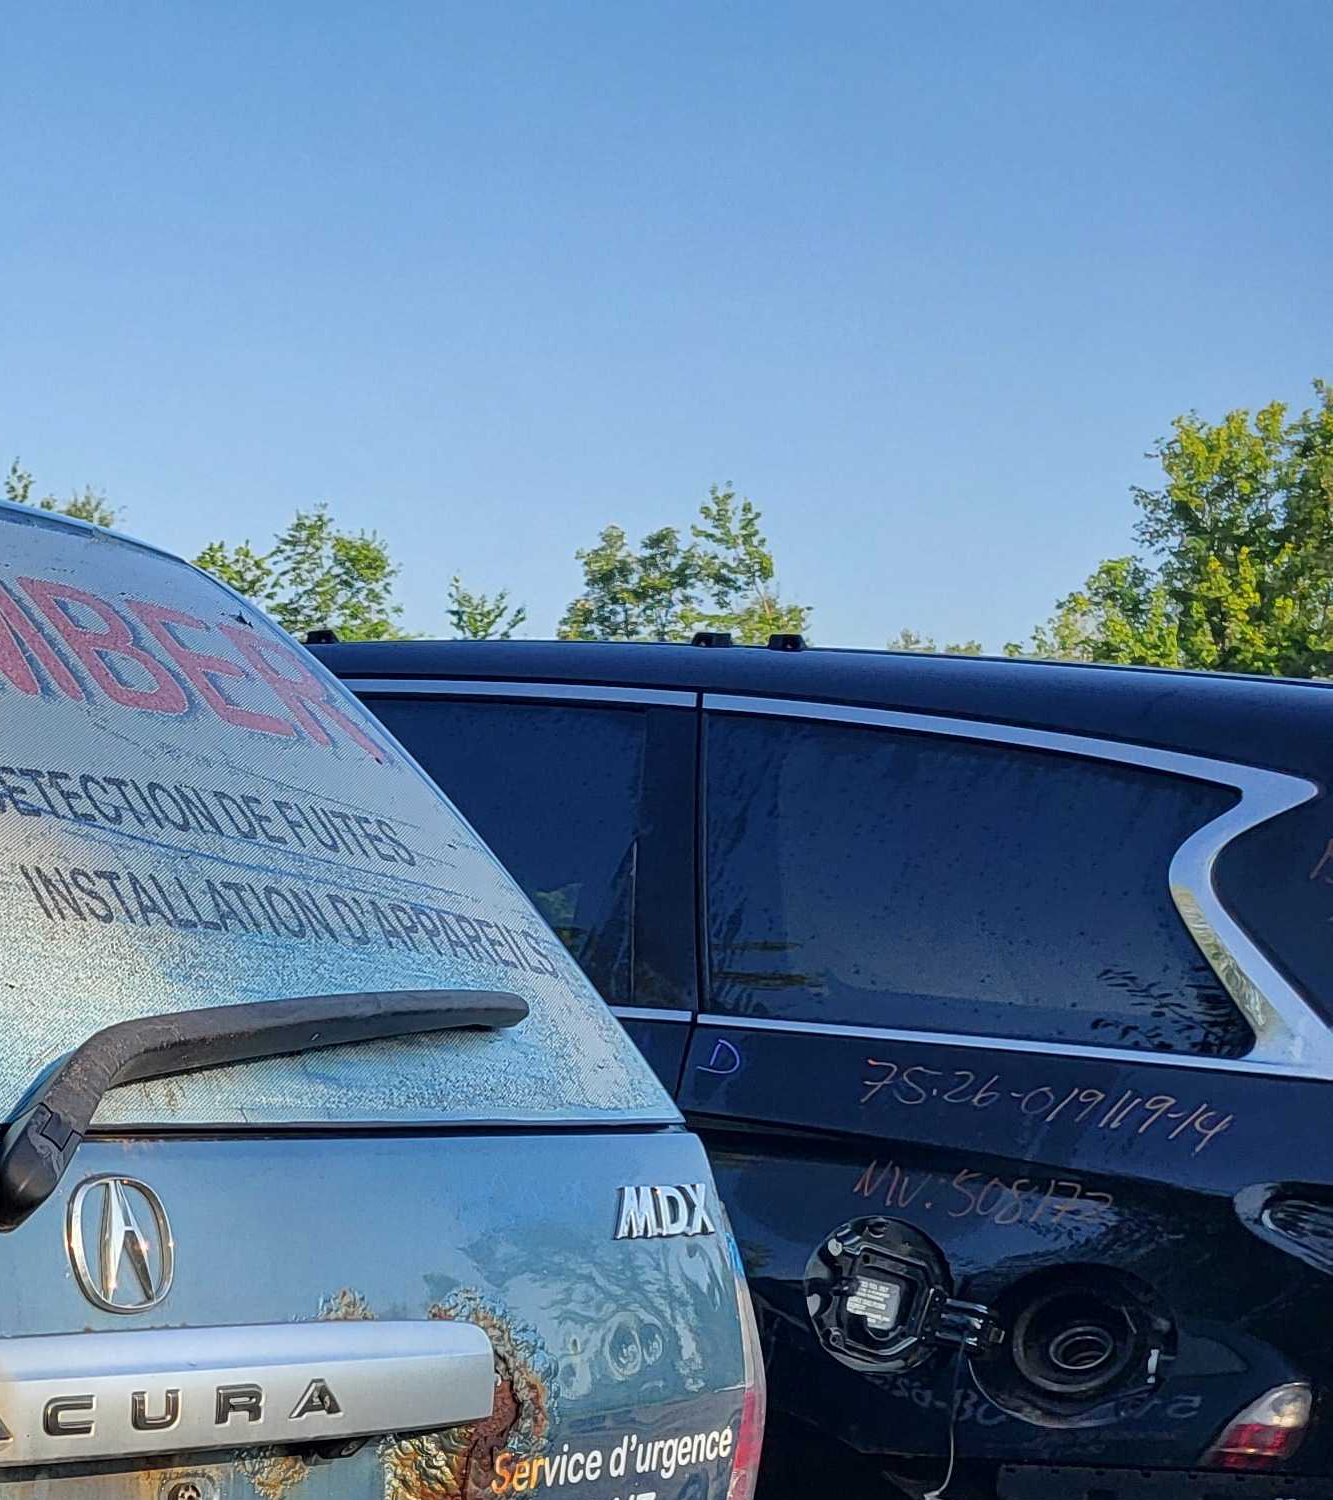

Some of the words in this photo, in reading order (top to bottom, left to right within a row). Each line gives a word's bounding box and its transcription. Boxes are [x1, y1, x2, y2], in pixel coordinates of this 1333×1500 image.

[219, 788, 289, 845] DE
[286, 800, 417, 867] FUITES
[19, 863, 339, 945] INSTALLATION
[333, 898, 559, 979] D'APPAREILS
[614, 1183, 717, 1241] MDX
[490, 1437, 602, 1496] Service
[608, 1422, 734, 1483] d'urgence
